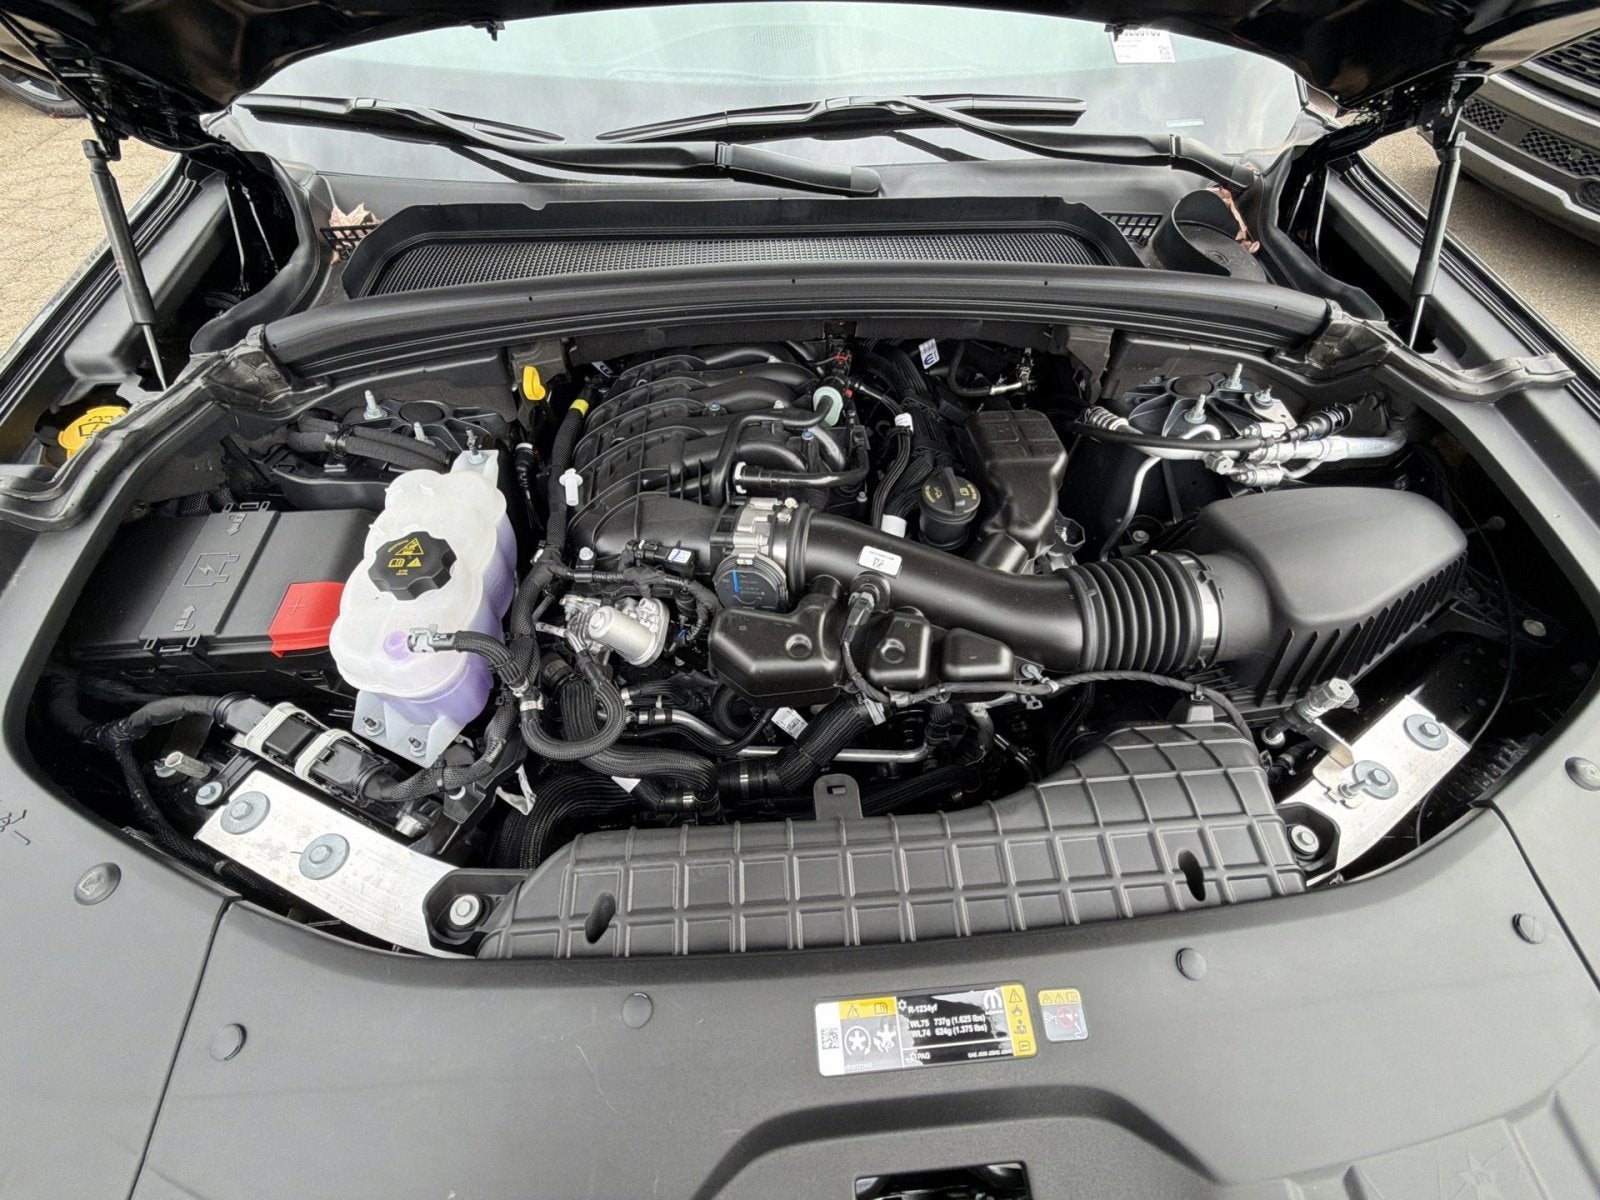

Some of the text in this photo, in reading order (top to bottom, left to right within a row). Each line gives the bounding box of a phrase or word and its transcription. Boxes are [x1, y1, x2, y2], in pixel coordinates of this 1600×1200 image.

[909, 1018, 930, 1028] WL75
[933, 1016, 951, 1027] 737g
[934, 1026, 953, 1037] 624g
